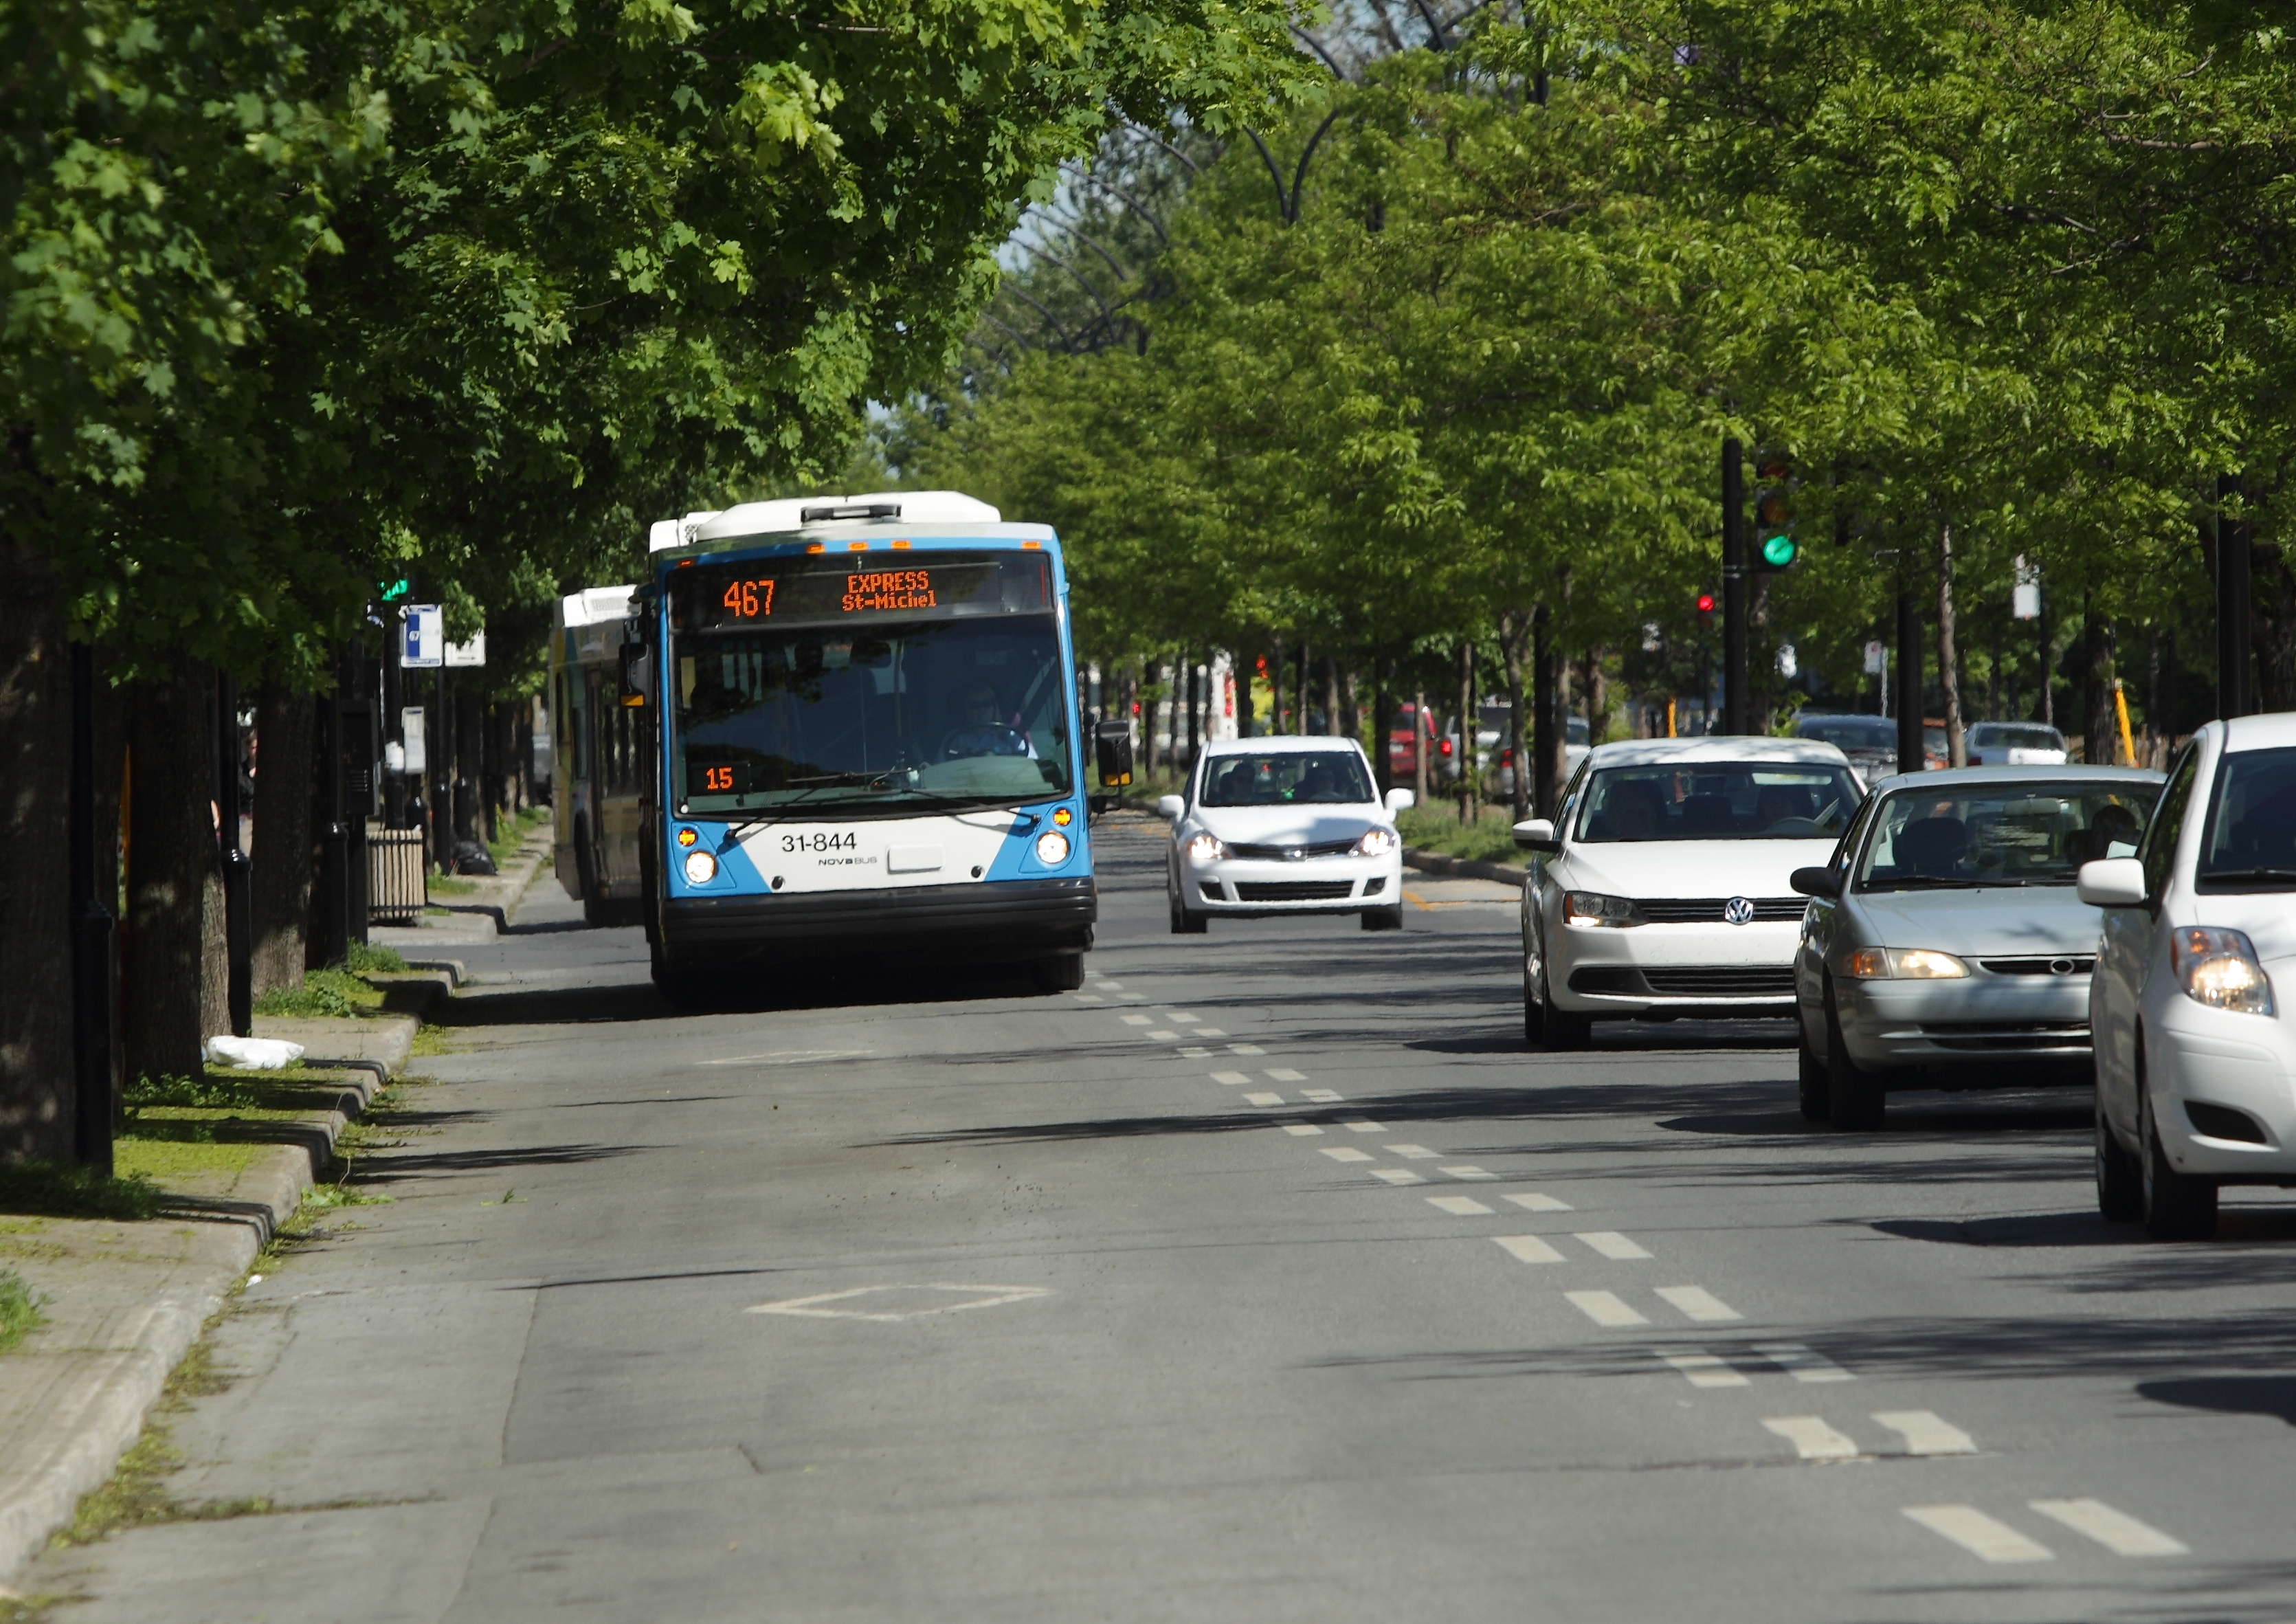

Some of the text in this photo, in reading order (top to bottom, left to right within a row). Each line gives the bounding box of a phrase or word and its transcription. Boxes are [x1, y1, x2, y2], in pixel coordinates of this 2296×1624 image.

[847, 570, 929, 594] EXPRESS
[724, 579, 775, 617] 467
[841, 590, 937, 612] St-Michel
[706, 767, 733, 790] 15
[781, 832, 858, 852] 31-844
